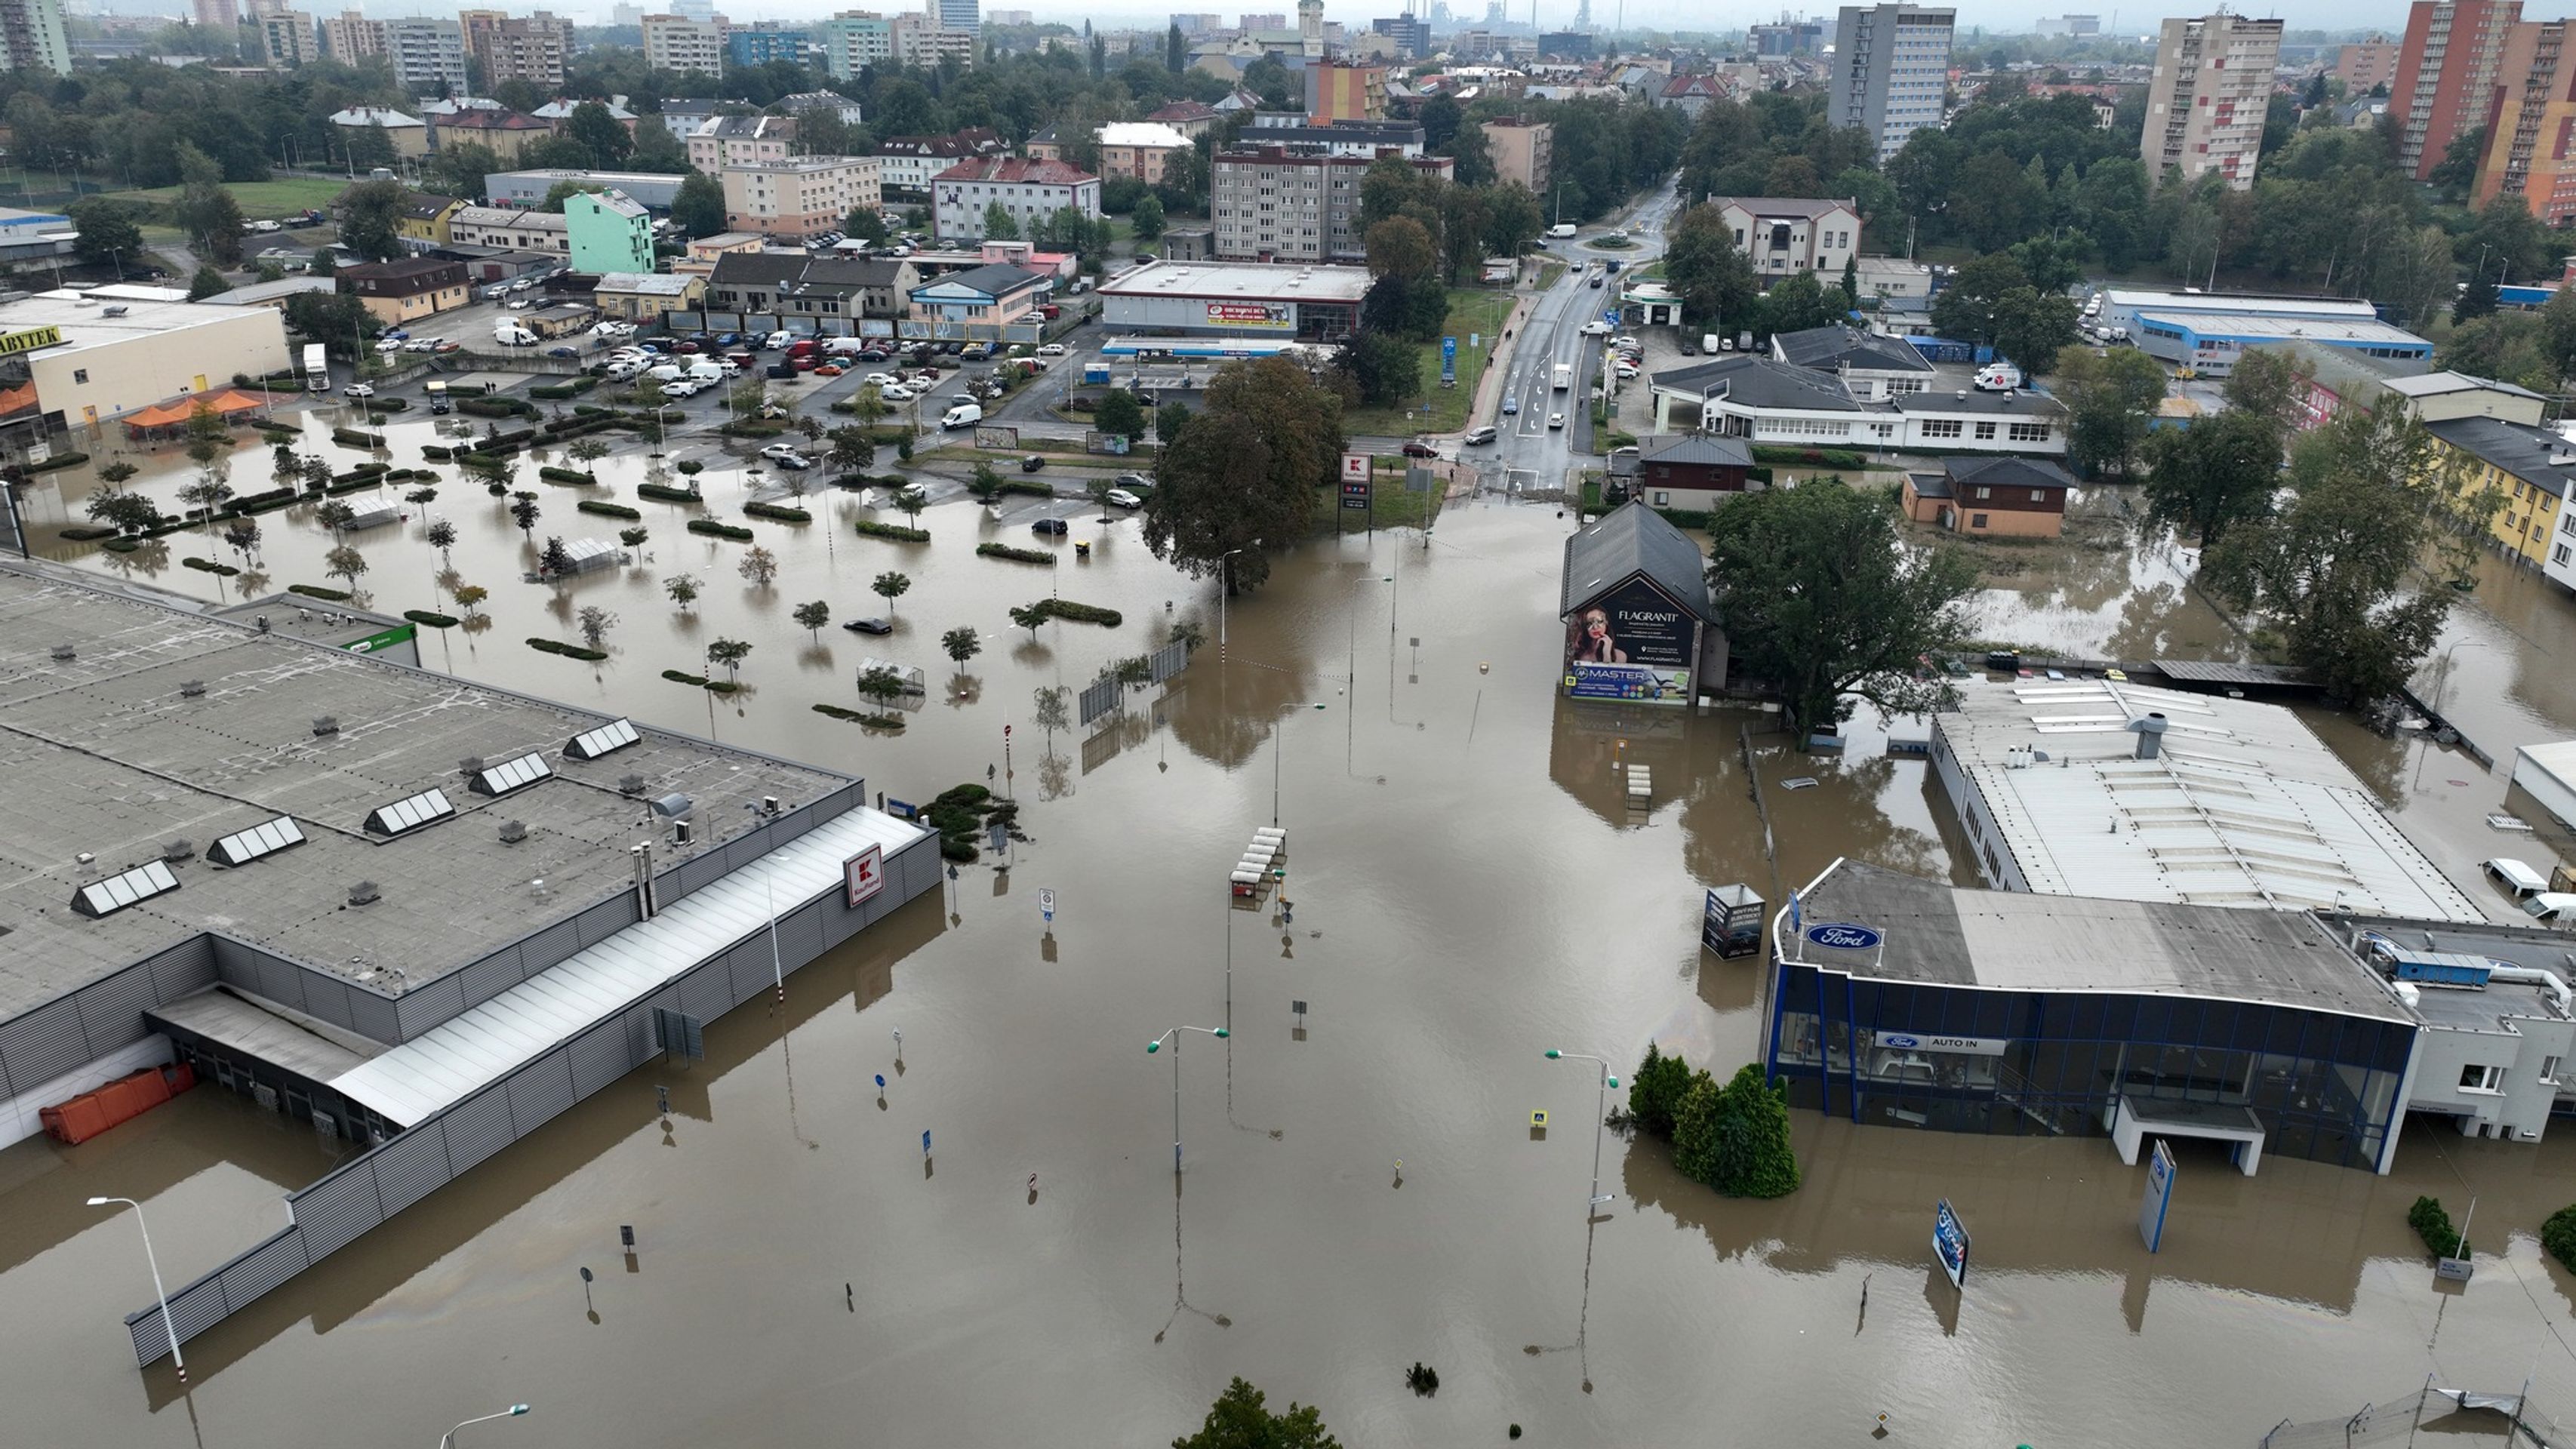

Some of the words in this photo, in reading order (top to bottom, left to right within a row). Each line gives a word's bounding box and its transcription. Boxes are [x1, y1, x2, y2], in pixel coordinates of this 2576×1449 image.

[1618, 610, 1676, 623] FLAGRANTI
[1590, 669, 1644, 680] MASTER
[854, 877, 880, 896] Kaufland
[1820, 928, 1866, 946] Ford
[1891, 1038, 1913, 1048] Ford
[1932, 1038, 1963, 1048] AUTO
[1965, 1040, 1977, 1048] IN
